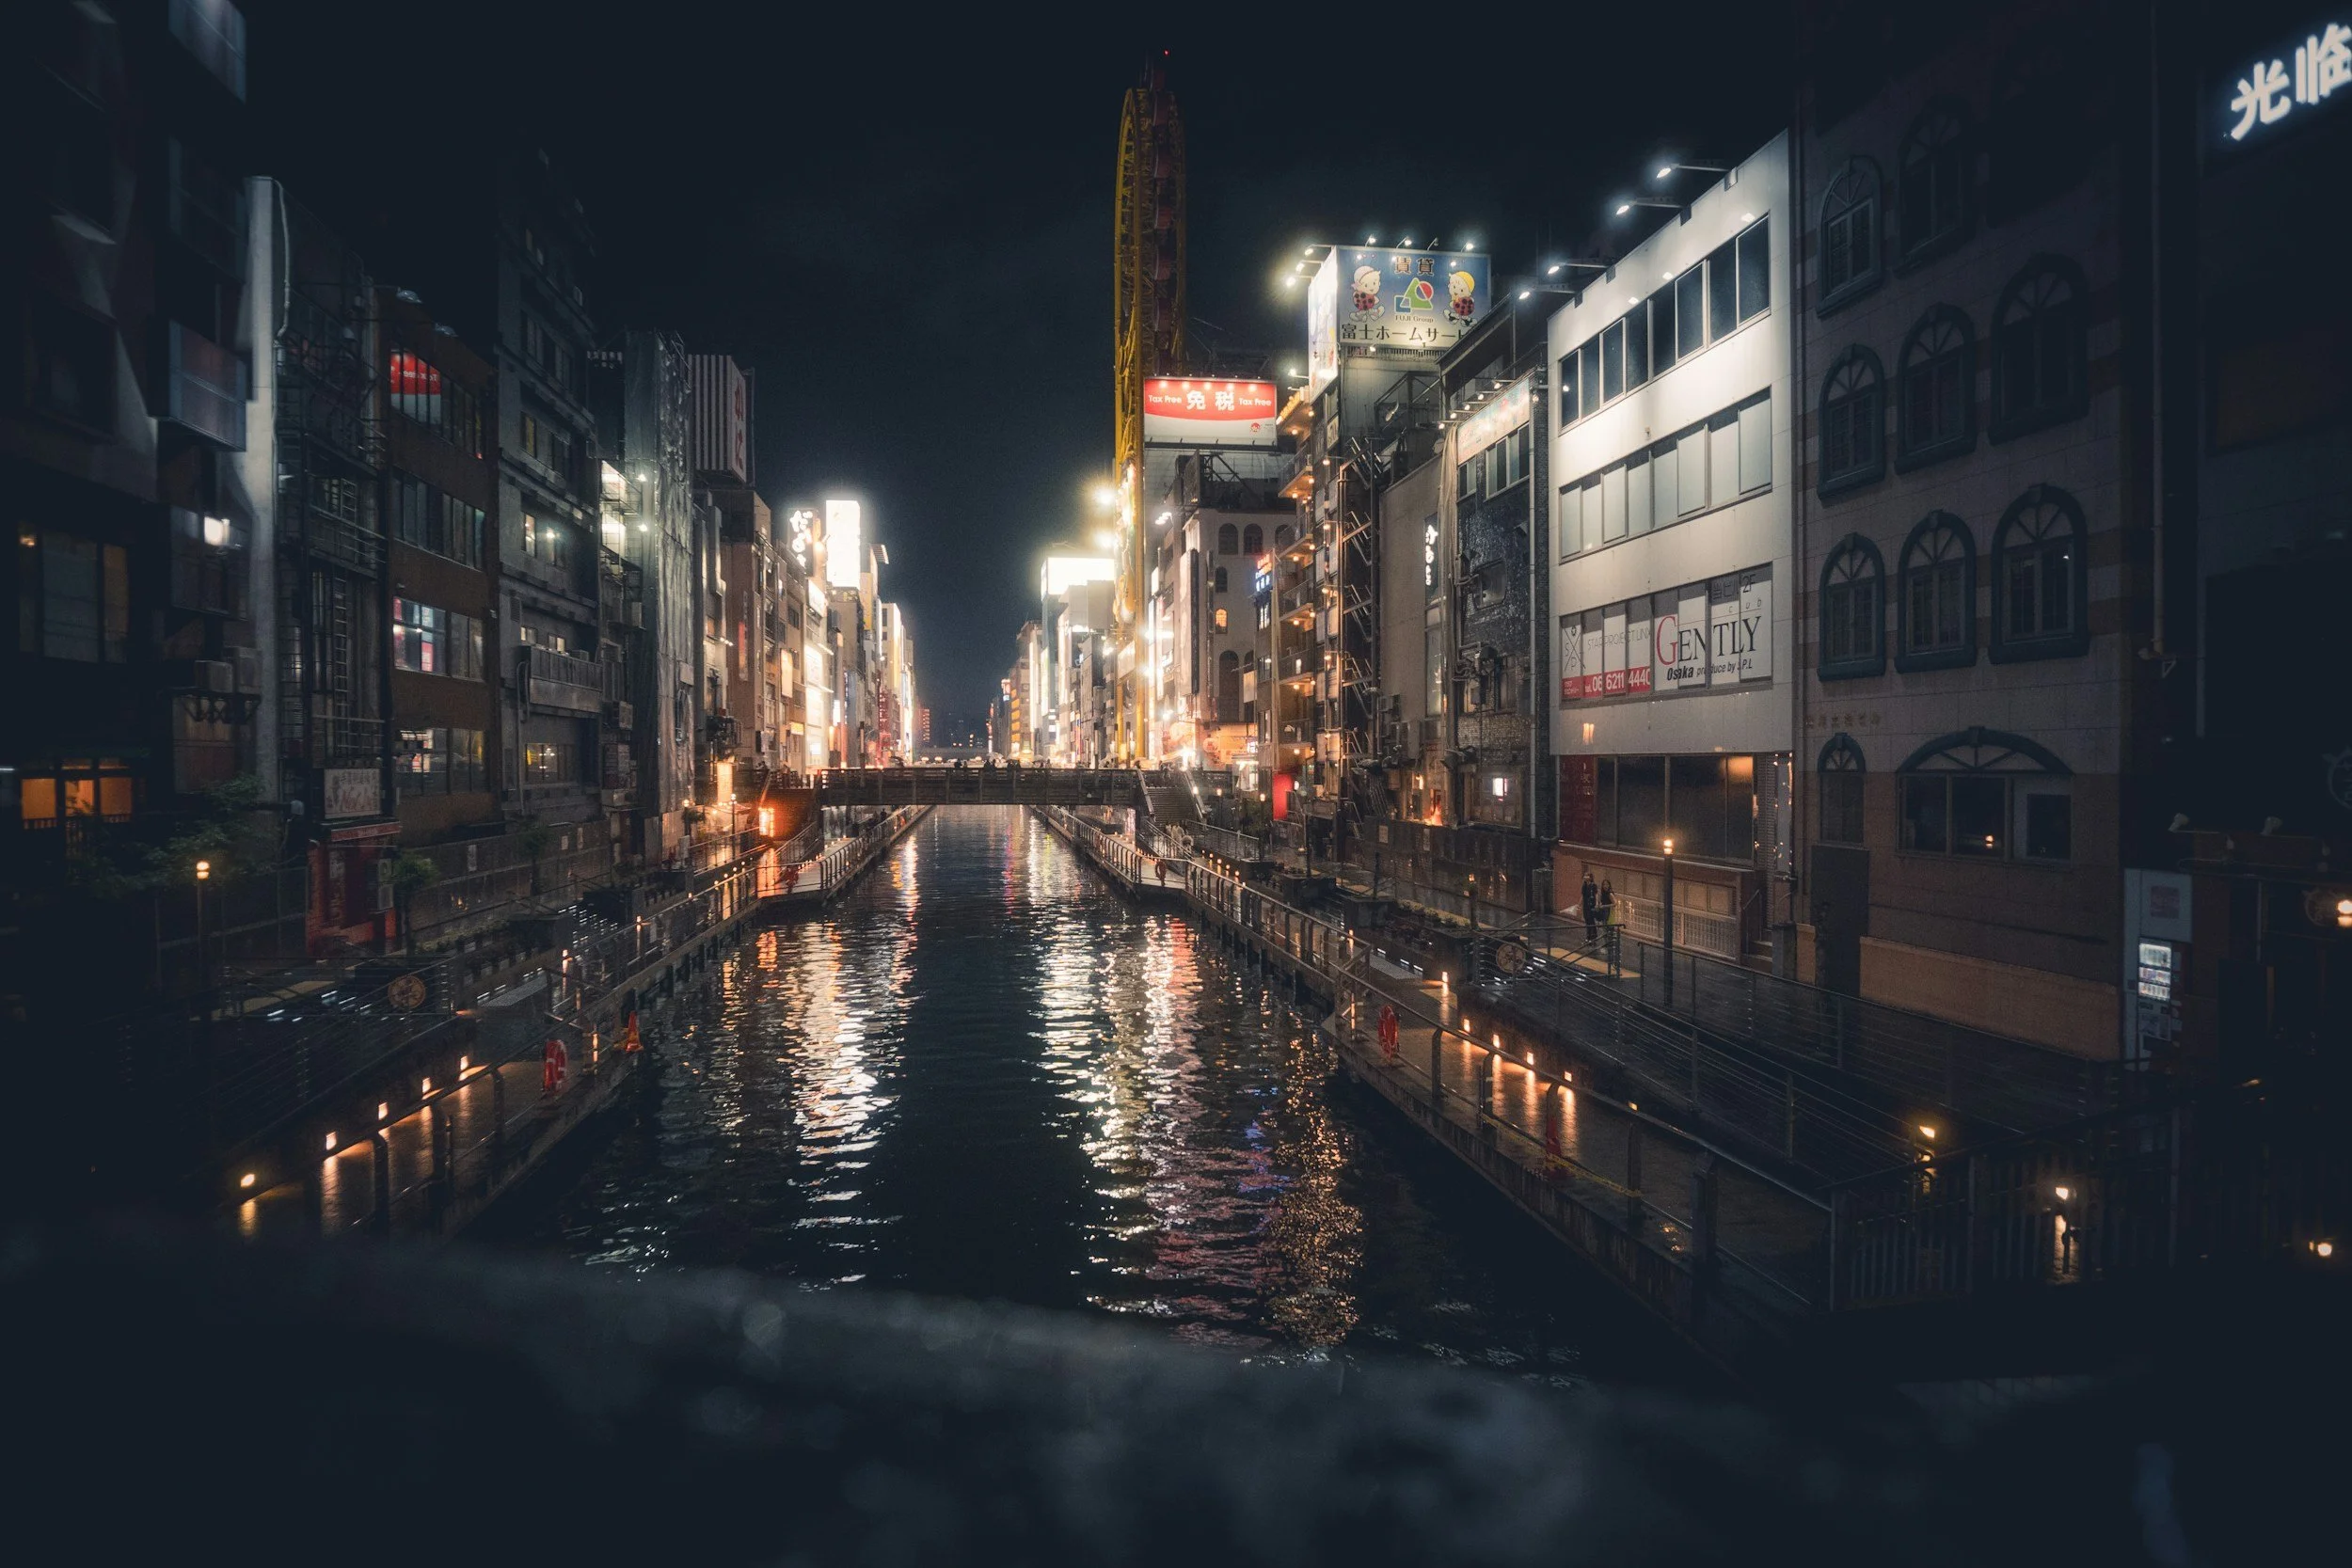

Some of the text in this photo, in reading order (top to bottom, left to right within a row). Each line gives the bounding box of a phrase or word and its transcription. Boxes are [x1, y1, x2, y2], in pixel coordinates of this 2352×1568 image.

[1149, 394, 1183, 404] Tax Free
[1186, 389, 1235, 411] 免税
[1239, 397, 1272, 407] Tax Free
[1742, 573, 1756, 594] 2F
[1656, 615, 1762, 666] GENTLY
[1606, 672, 1625, 690] 6211
[1666, 665, 1694, 682] Osaka
[1696, 663, 1725, 677] prduce
[1727, 660, 1737, 674] by
